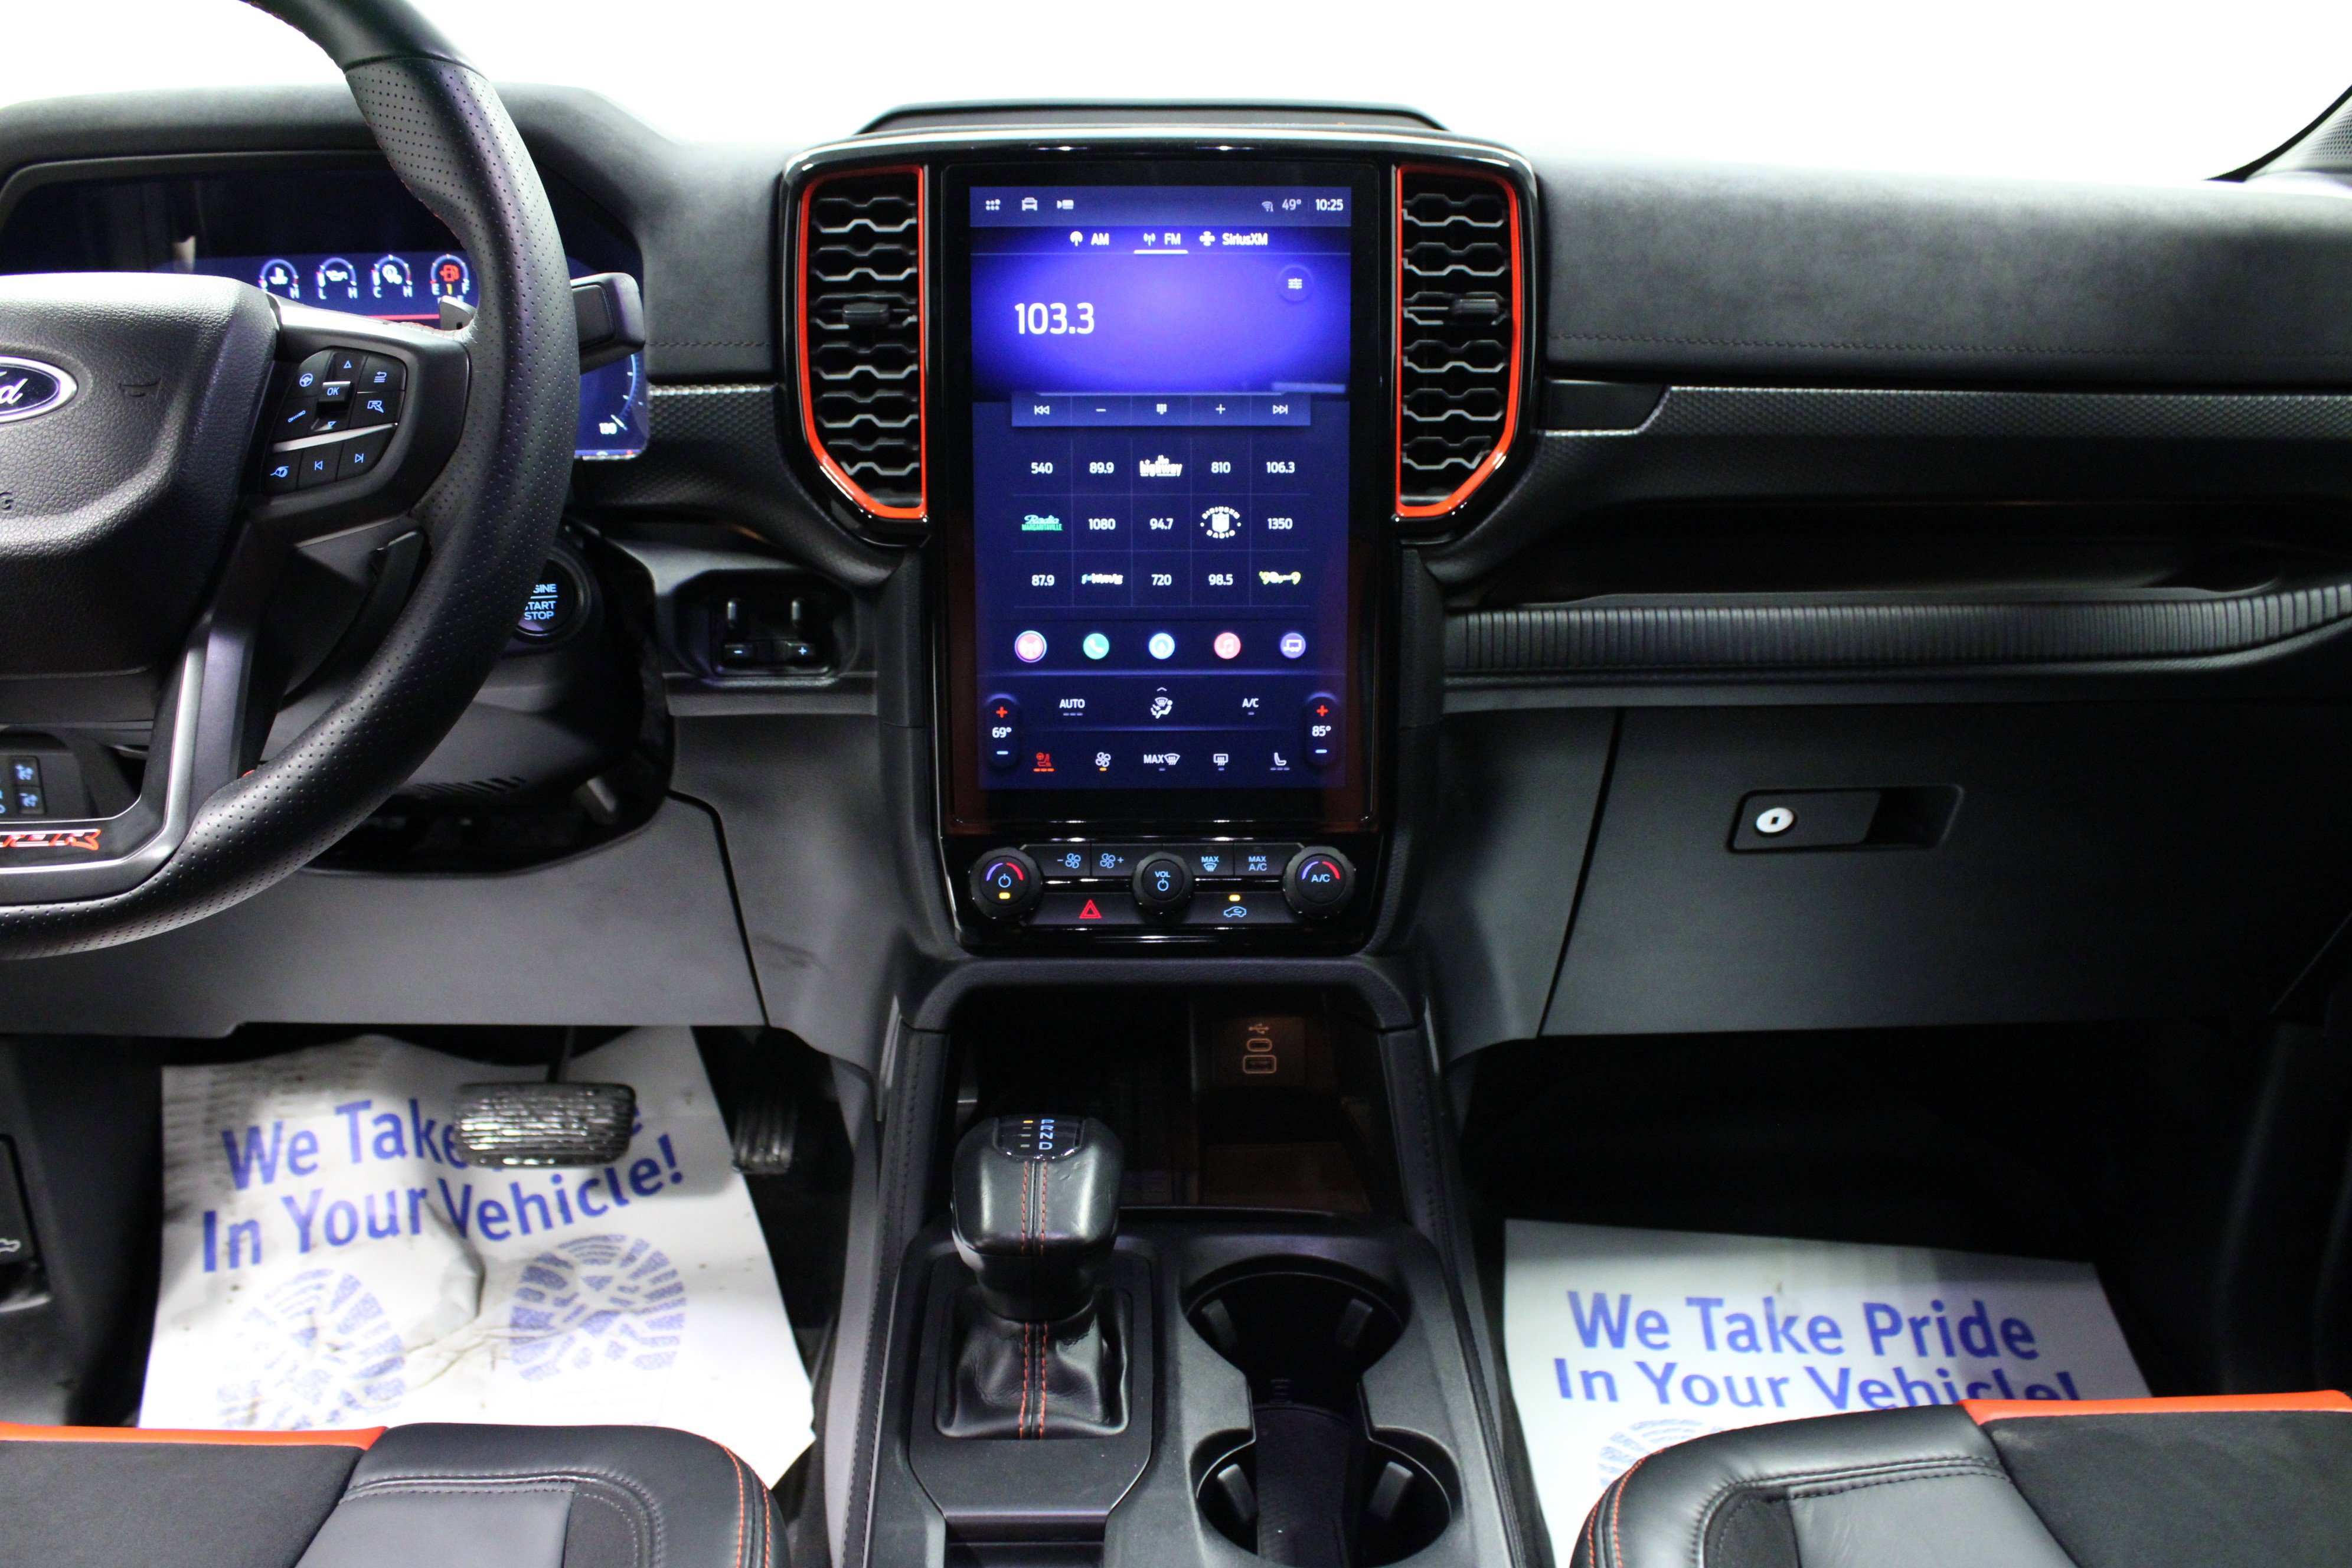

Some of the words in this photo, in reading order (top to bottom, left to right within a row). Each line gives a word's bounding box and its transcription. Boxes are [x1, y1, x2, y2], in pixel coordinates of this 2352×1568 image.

[1315, 198, 1344, 211] 10:25
[1090, 233, 1110, 246] AM
[1164, 233, 1181, 246] FM
[1221, 232, 1268, 246] SiriusXM
[431, 283, 440, 296] E
[461, 282, 470, 295] F
[1014, 302, 1095, 335] 103.3
[326, 387, 340, 396] OK
[1031, 462, 1053, 474] 540
[1089, 462, 1115, 474] 89.9
[1211, 461, 1231, 473] 810
[1266, 461, 1295, 473] 106.3
[1088, 518, 1116, 530] 1080
[1149, 518, 1174, 530] 94.7
[1267, 517, 1293, 530] 1350
[1031, 574, 1055, 586] 87.9
[1151, 574, 1172, 586] 720
[1208, 573, 1233, 586] 98.5
[524, 610, 554, 620] STOP
[1059, 698, 1086, 708] AUTO
[1242, 698, 1259, 708] A/C
[1143, 754, 1164, 764] MAX
[1248, 863, 1268, 871] A/C
[1311, 874, 1330, 883] A/C
[222, 1121, 319, 1190] We
[335, 1098, 467, 1169] Take
[1038, 1141, 1053, 1150] D
[203, 1210, 262, 1272] In
[281, 1188, 427, 1254] Your
[437, 1133, 684, 1241] Vehicle!
[1567, 1291, 1671, 1352] We
[1686, 1296, 1844, 1355] Take
[1863, 1300, 2039, 1359] Pride
[1555, 1358, 1618, 1402] In
[1636, 1361, 1789, 1407] Your
